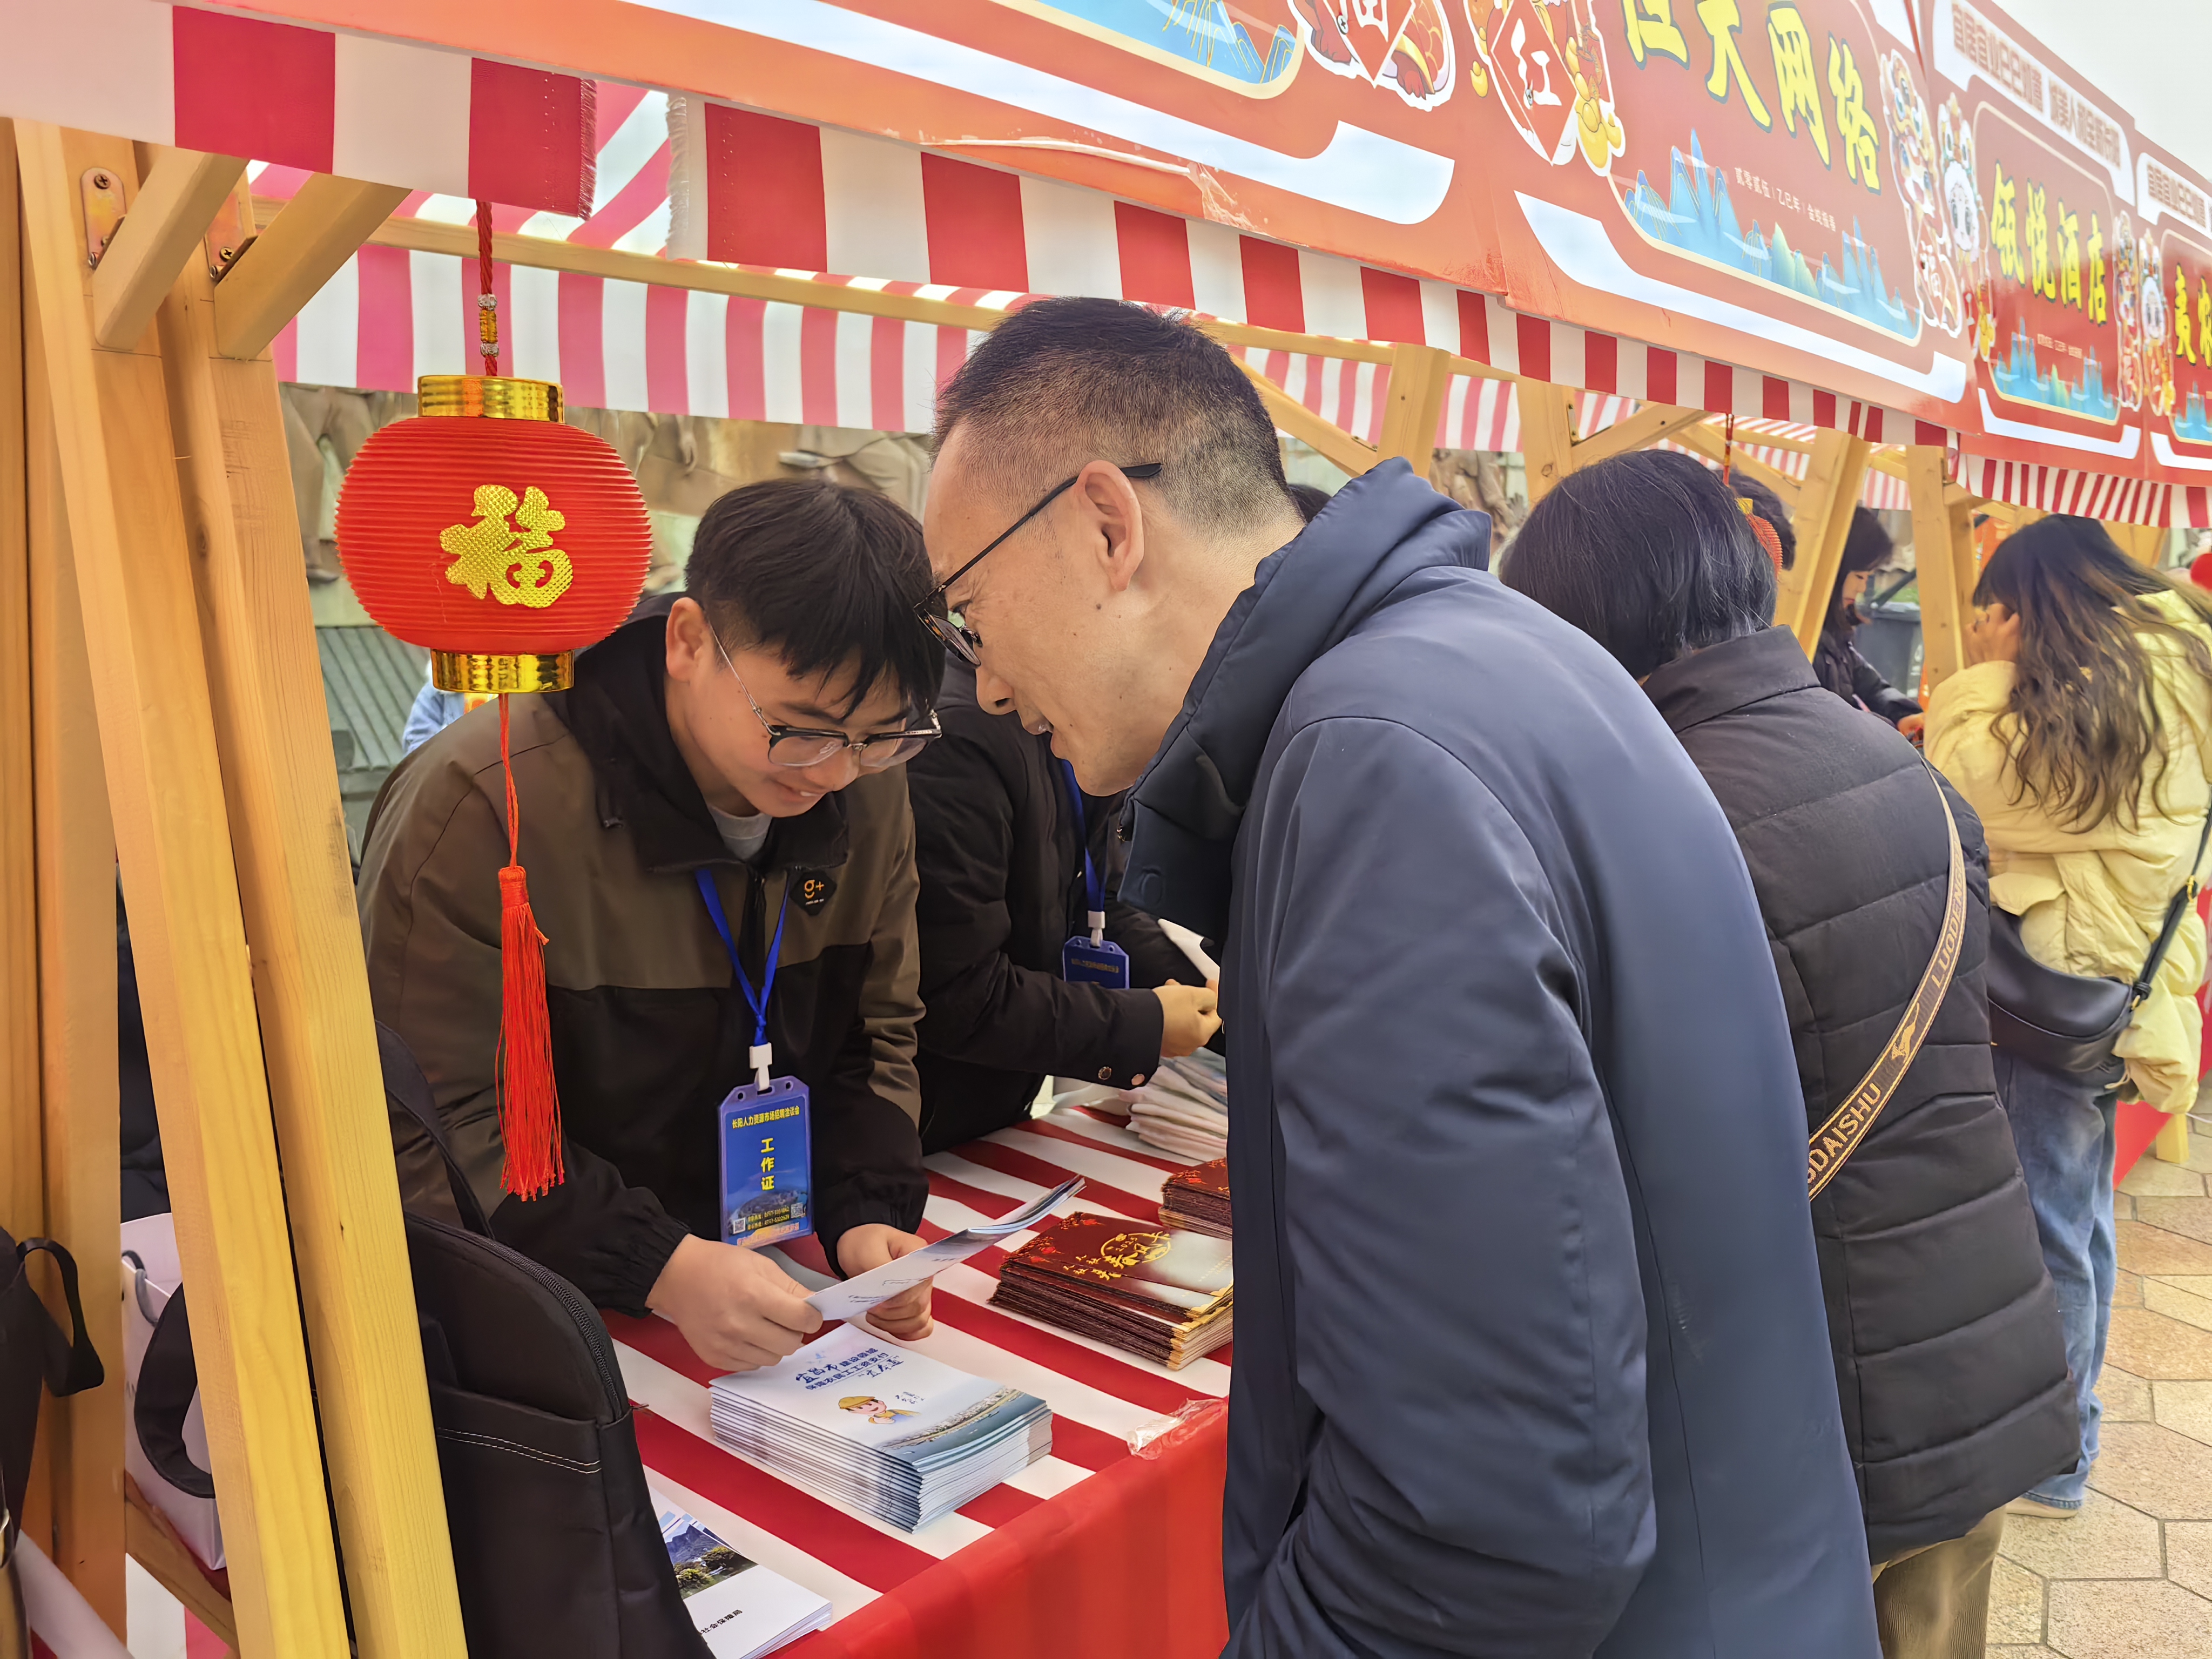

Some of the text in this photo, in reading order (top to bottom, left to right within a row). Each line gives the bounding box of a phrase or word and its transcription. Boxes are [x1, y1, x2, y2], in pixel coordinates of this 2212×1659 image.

[439, 484, 574, 609] 福
[760, 1137, 775, 1191] 工作证
[1116, 1237, 1138, 1251] 2025
[700, 1609, 743, 1634] 社会保障局
